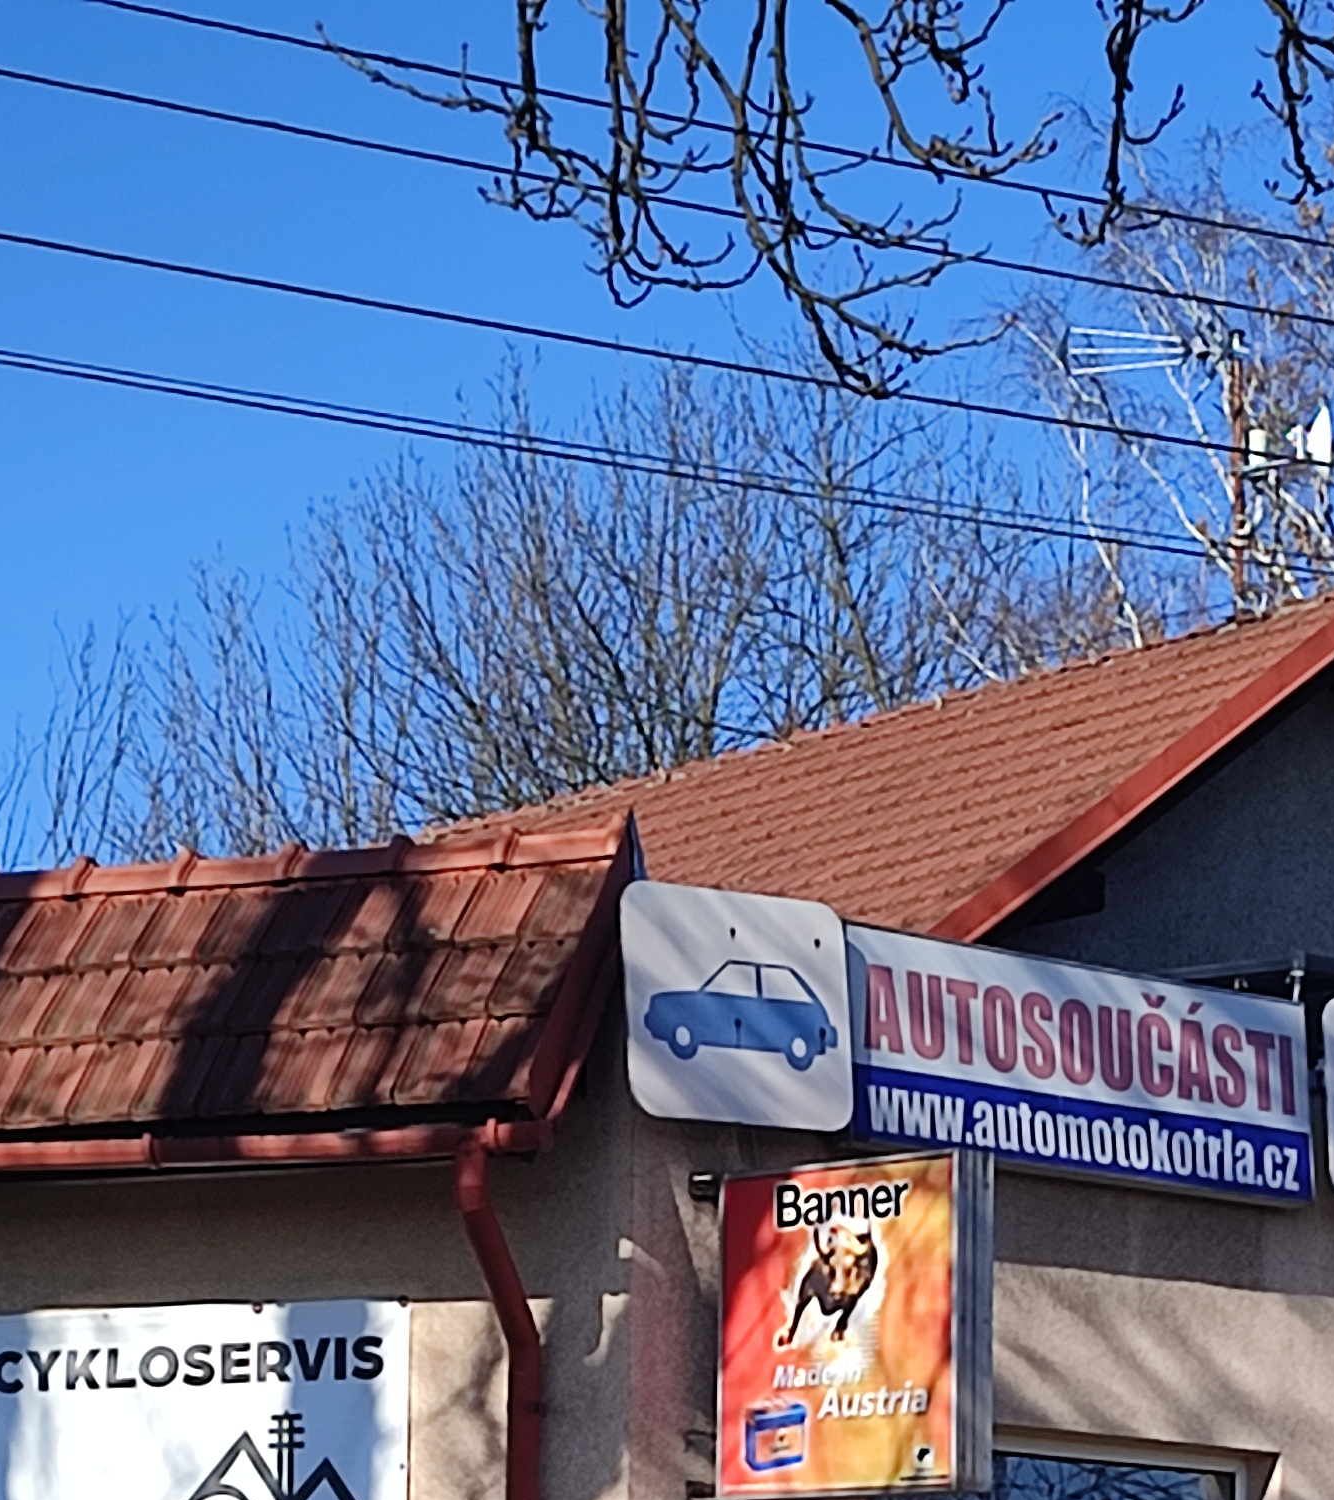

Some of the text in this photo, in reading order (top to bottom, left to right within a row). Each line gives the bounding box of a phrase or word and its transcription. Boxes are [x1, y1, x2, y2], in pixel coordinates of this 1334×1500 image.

[866, 962, 1296, 1116] AUTOSOUČÁSTI
[867, 1082, 1301, 1194] www.automotokotrla.cz
[775, 1181, 909, 1229] Banner
[773, 1364, 829, 1389] Made
[817, 1382, 929, 1420] Austria
